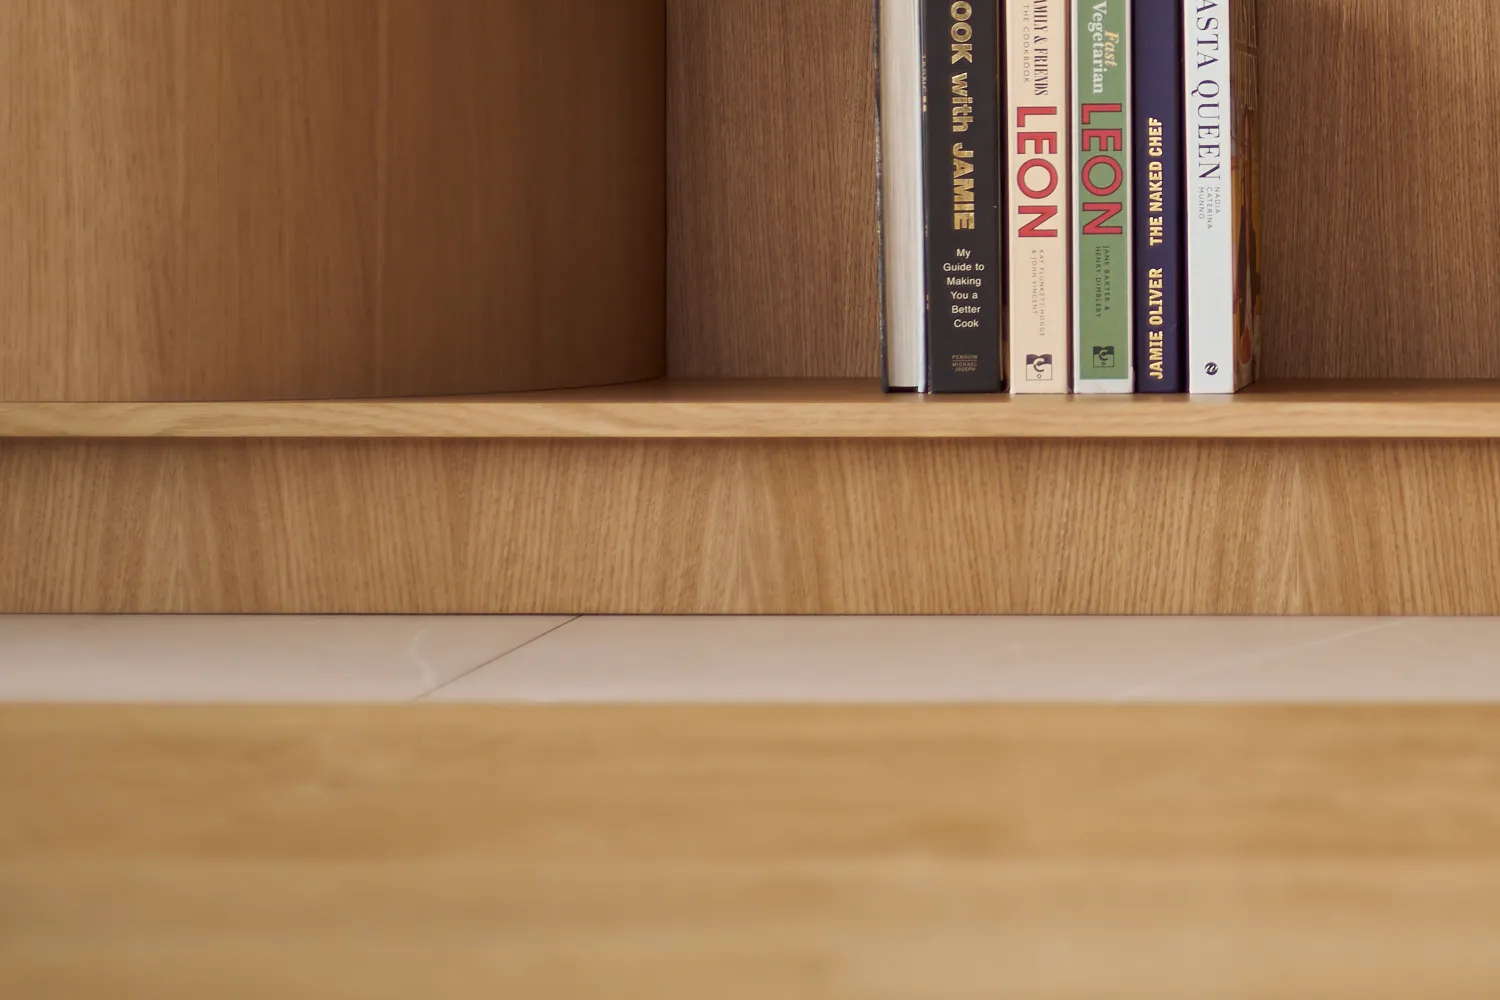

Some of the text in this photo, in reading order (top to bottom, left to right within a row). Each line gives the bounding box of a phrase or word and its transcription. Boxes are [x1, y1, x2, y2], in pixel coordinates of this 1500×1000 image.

[1034, 35, 1048, 44] &
[1088, 0, 1108, 94] Vegetarian
[1104, 30, 1120, 67] Fast
[1034, 48, 1049, 96] FRIENDS
[951, 72, 974, 133] with
[1191, 80, 1221, 180] QUEEN
[952, 142, 975, 230] JAMIE
[1016, 106, 1058, 238] LEON
[1081, 103, 1123, 235] LEON
[943, 262, 985, 272] Guide to
[956, 248, 971, 259] My
[1148, 117, 1163, 380] JAMIE OLIVER THE NAKED CHEF
[946, 277, 982, 288] Making
[951, 291, 979, 300] You a
[951, 305, 981, 314] Better
[953, 319, 979, 328] Cook
